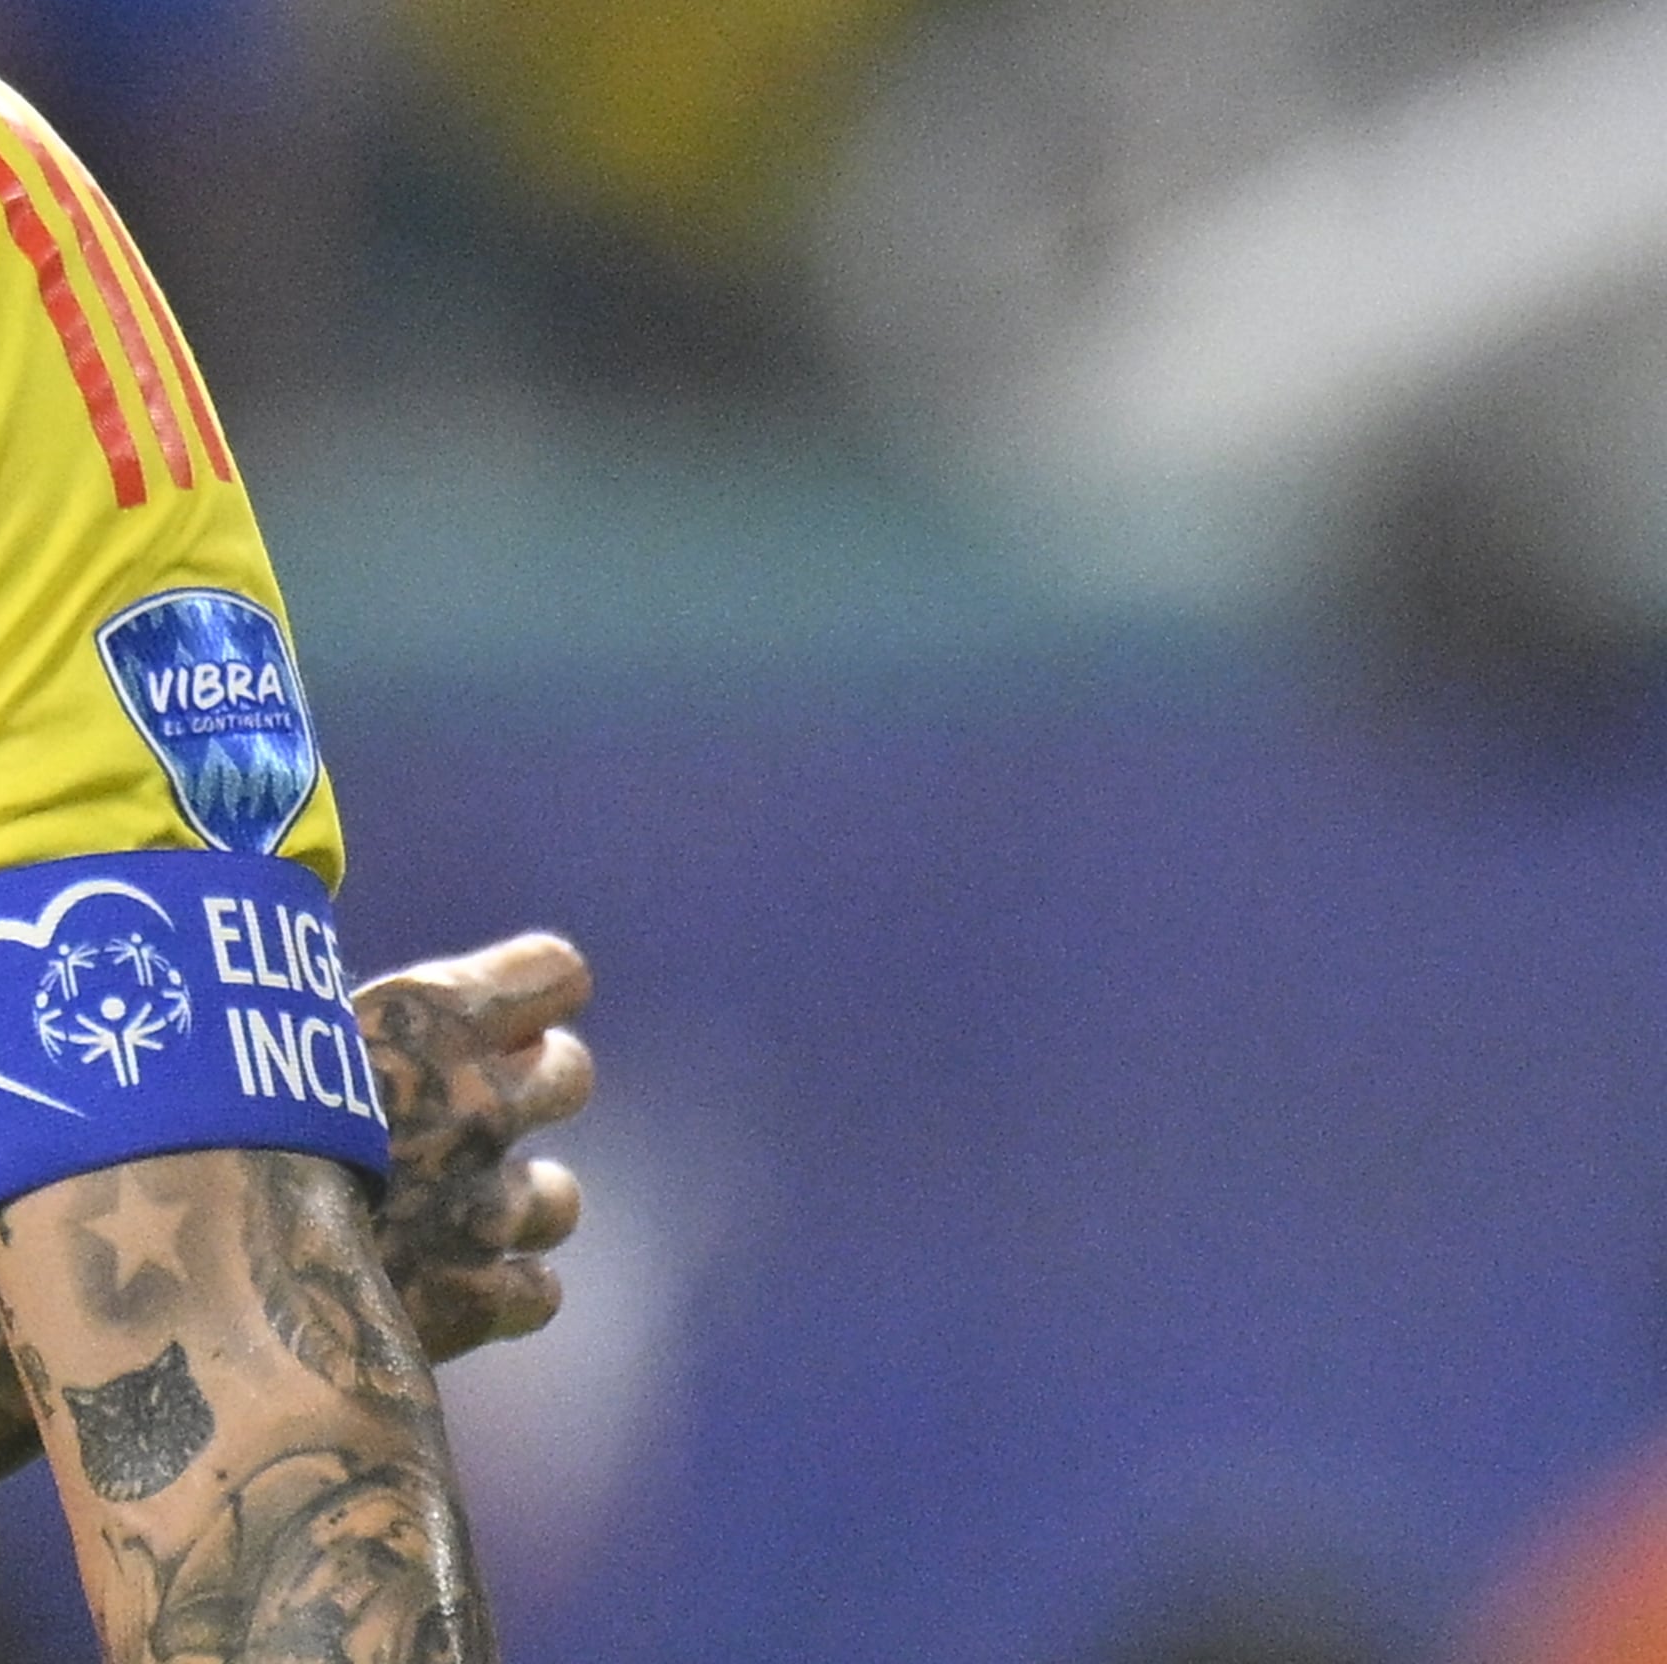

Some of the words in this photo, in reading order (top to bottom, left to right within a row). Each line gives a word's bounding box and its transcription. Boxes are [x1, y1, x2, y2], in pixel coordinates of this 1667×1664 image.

[147, 661, 286, 714] VIBRA
[163, 720, 185, 736] EL
[192, 712, 292, 733] CONTINENTE
